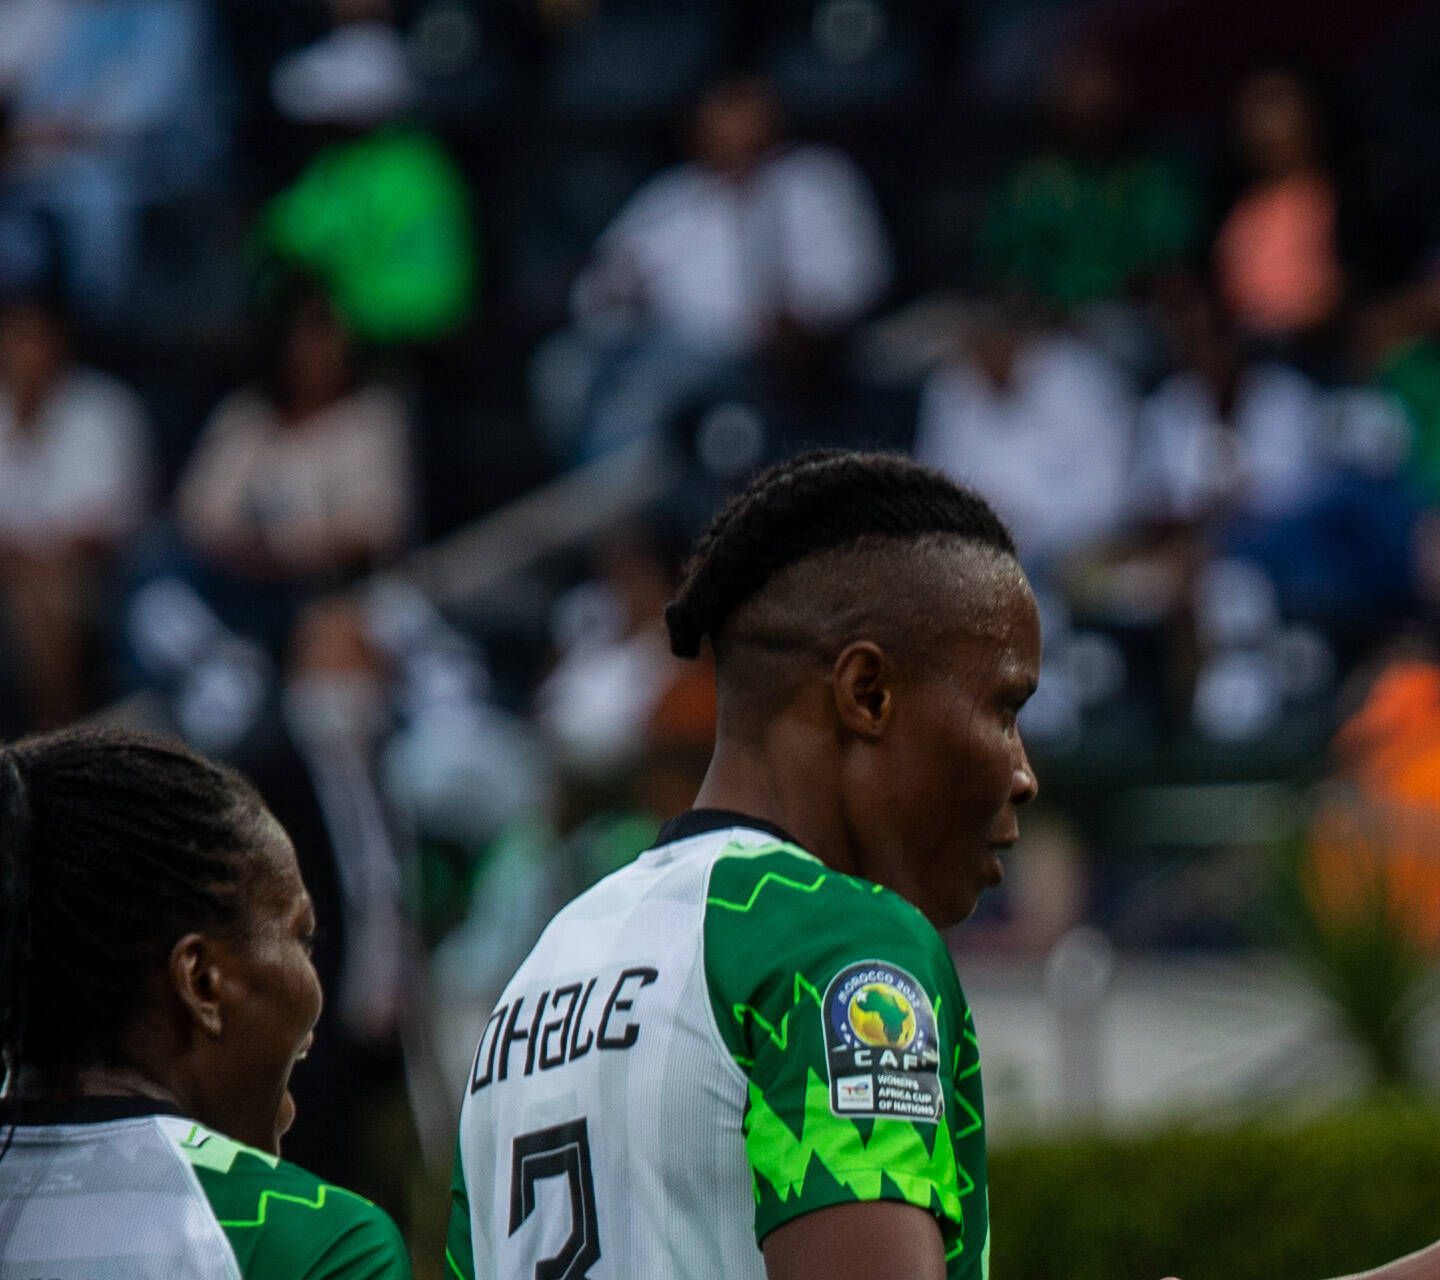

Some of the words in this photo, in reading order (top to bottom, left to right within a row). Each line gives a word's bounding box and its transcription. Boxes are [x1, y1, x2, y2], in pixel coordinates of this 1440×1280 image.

[837, 970, 894, 1004] MOROCCO
[854, 1048, 918, 1071] CAF
[878, 1087, 912, 1101] AFRICA
[912, 1091, 932, 1104] CUP
[878, 1100, 893, 1111] OF
[893, 1101, 935, 1116] NATIONS
